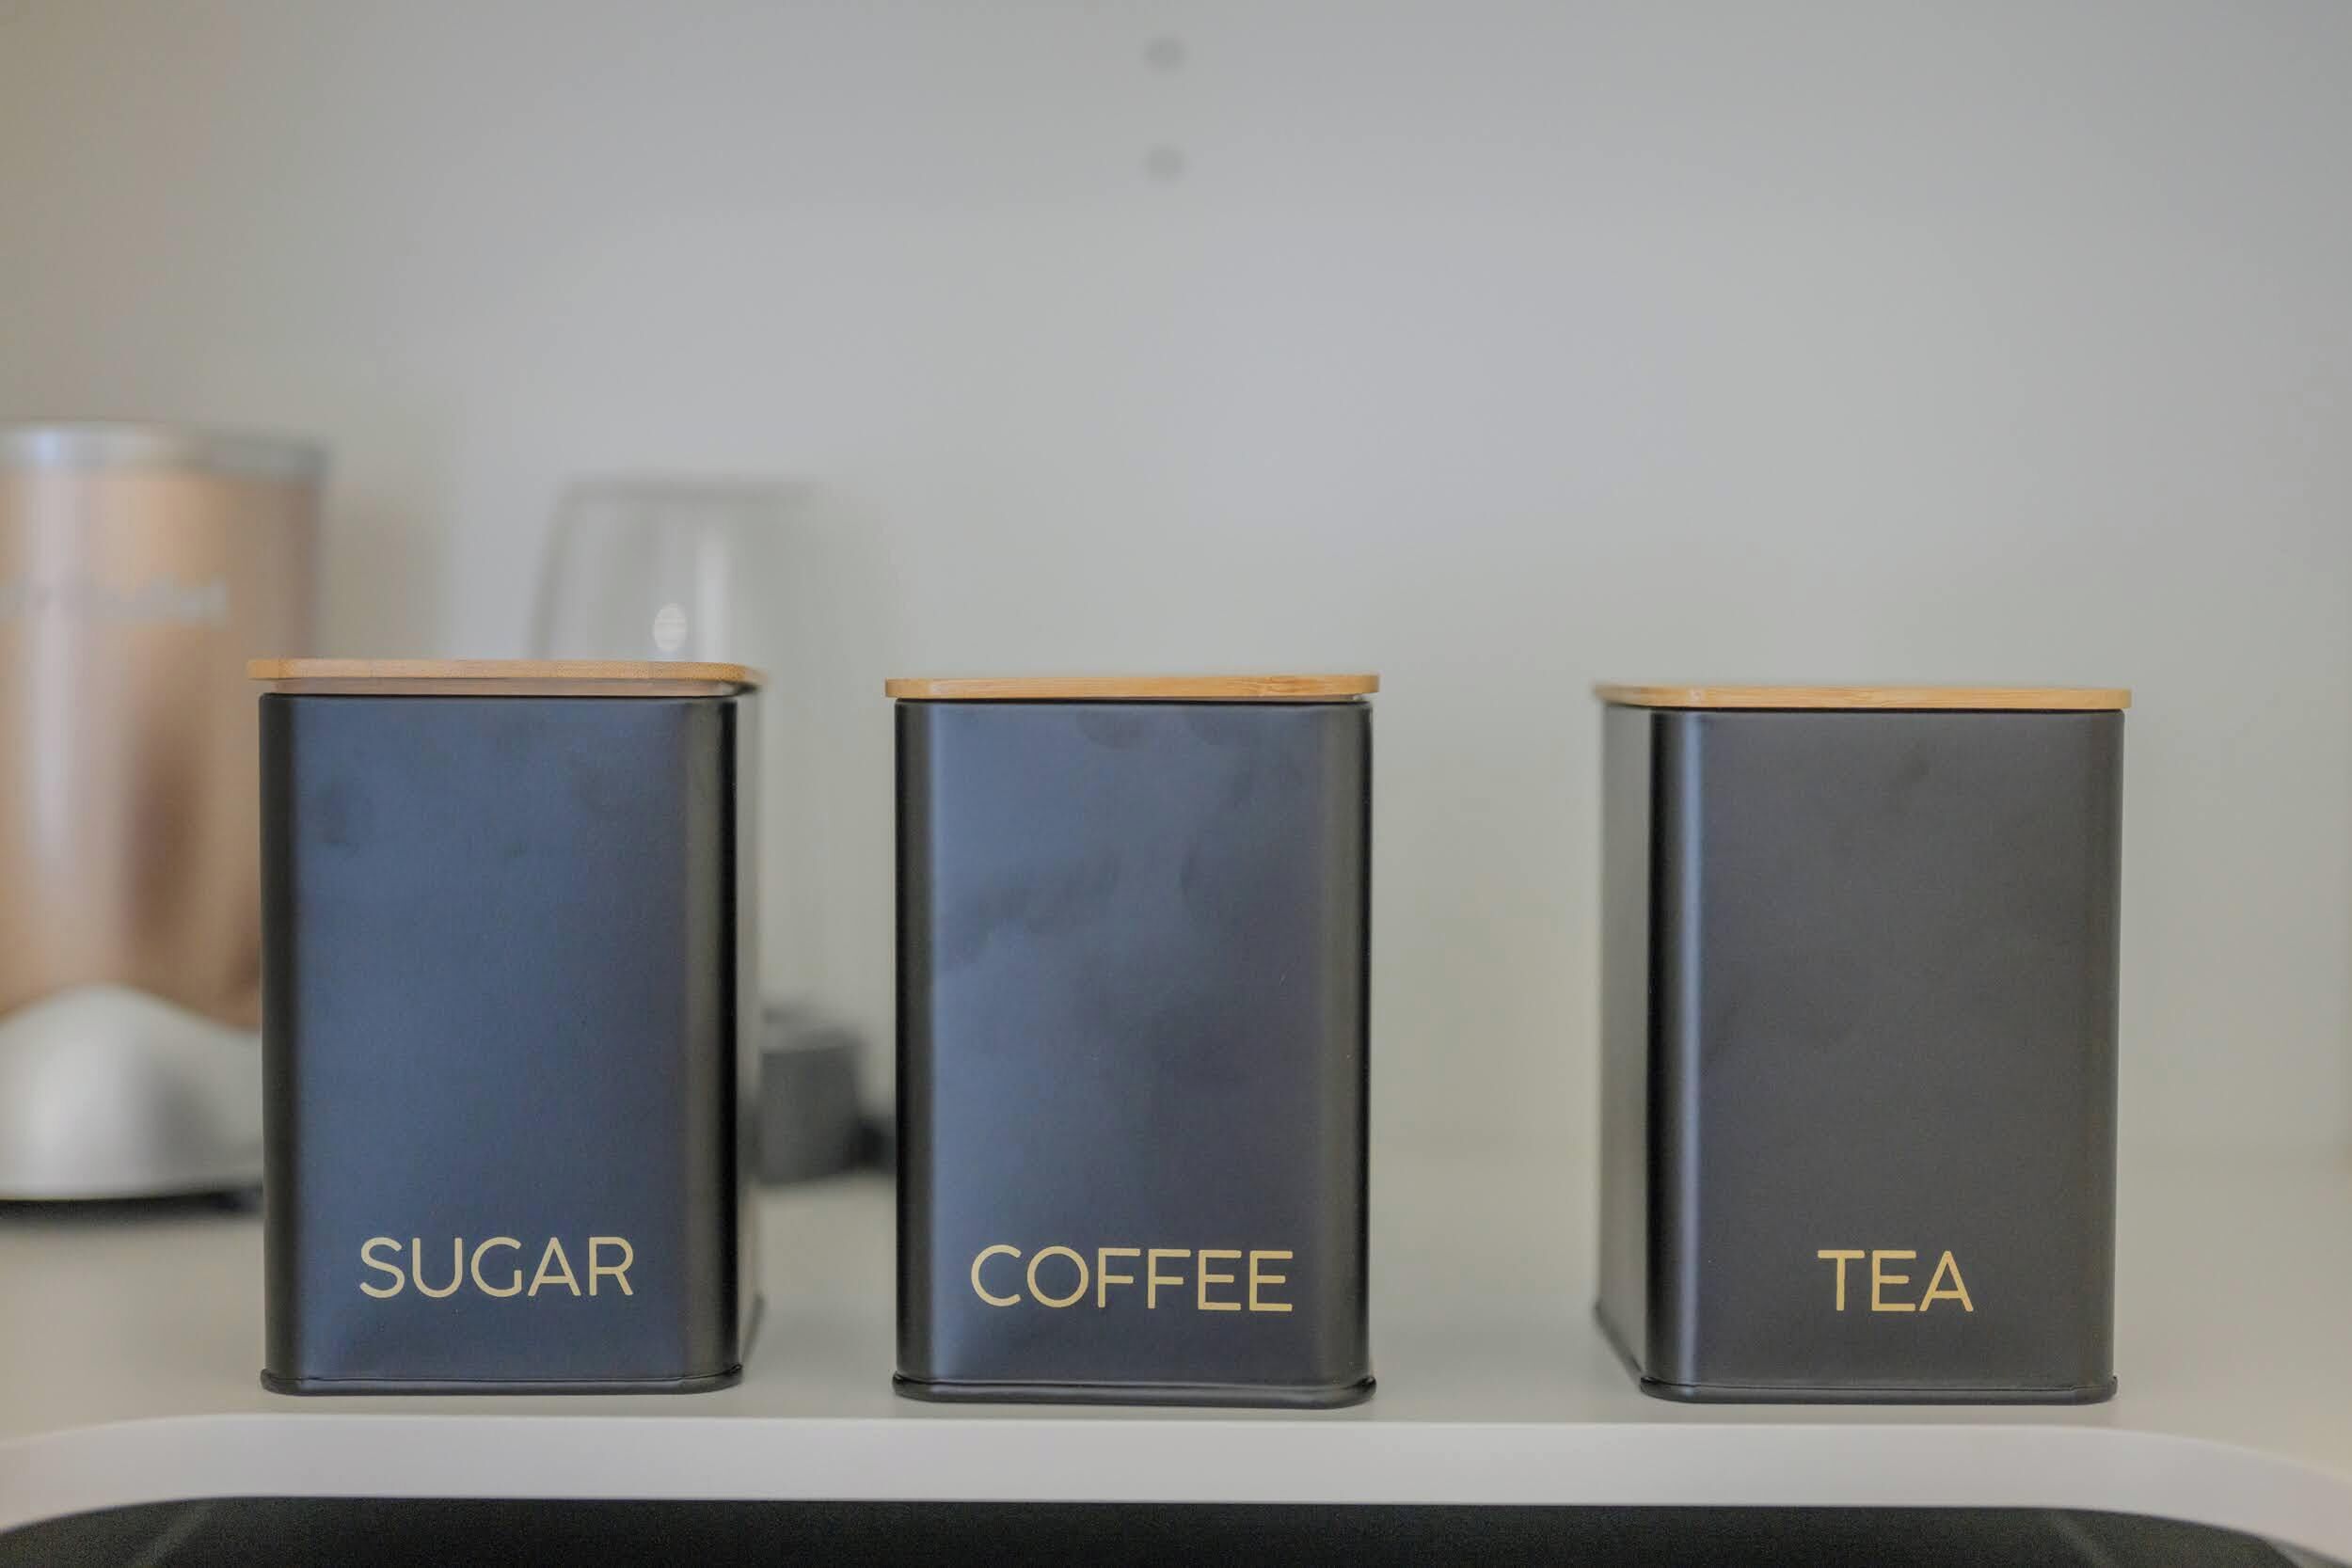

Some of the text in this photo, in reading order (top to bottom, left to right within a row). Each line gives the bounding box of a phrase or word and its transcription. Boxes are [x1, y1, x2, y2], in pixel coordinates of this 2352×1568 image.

[359, 1237, 634, 1297] SUGAR
[971, 1244, 1294, 1312] COFFEE
[1818, 1250, 1974, 1312] TEA
